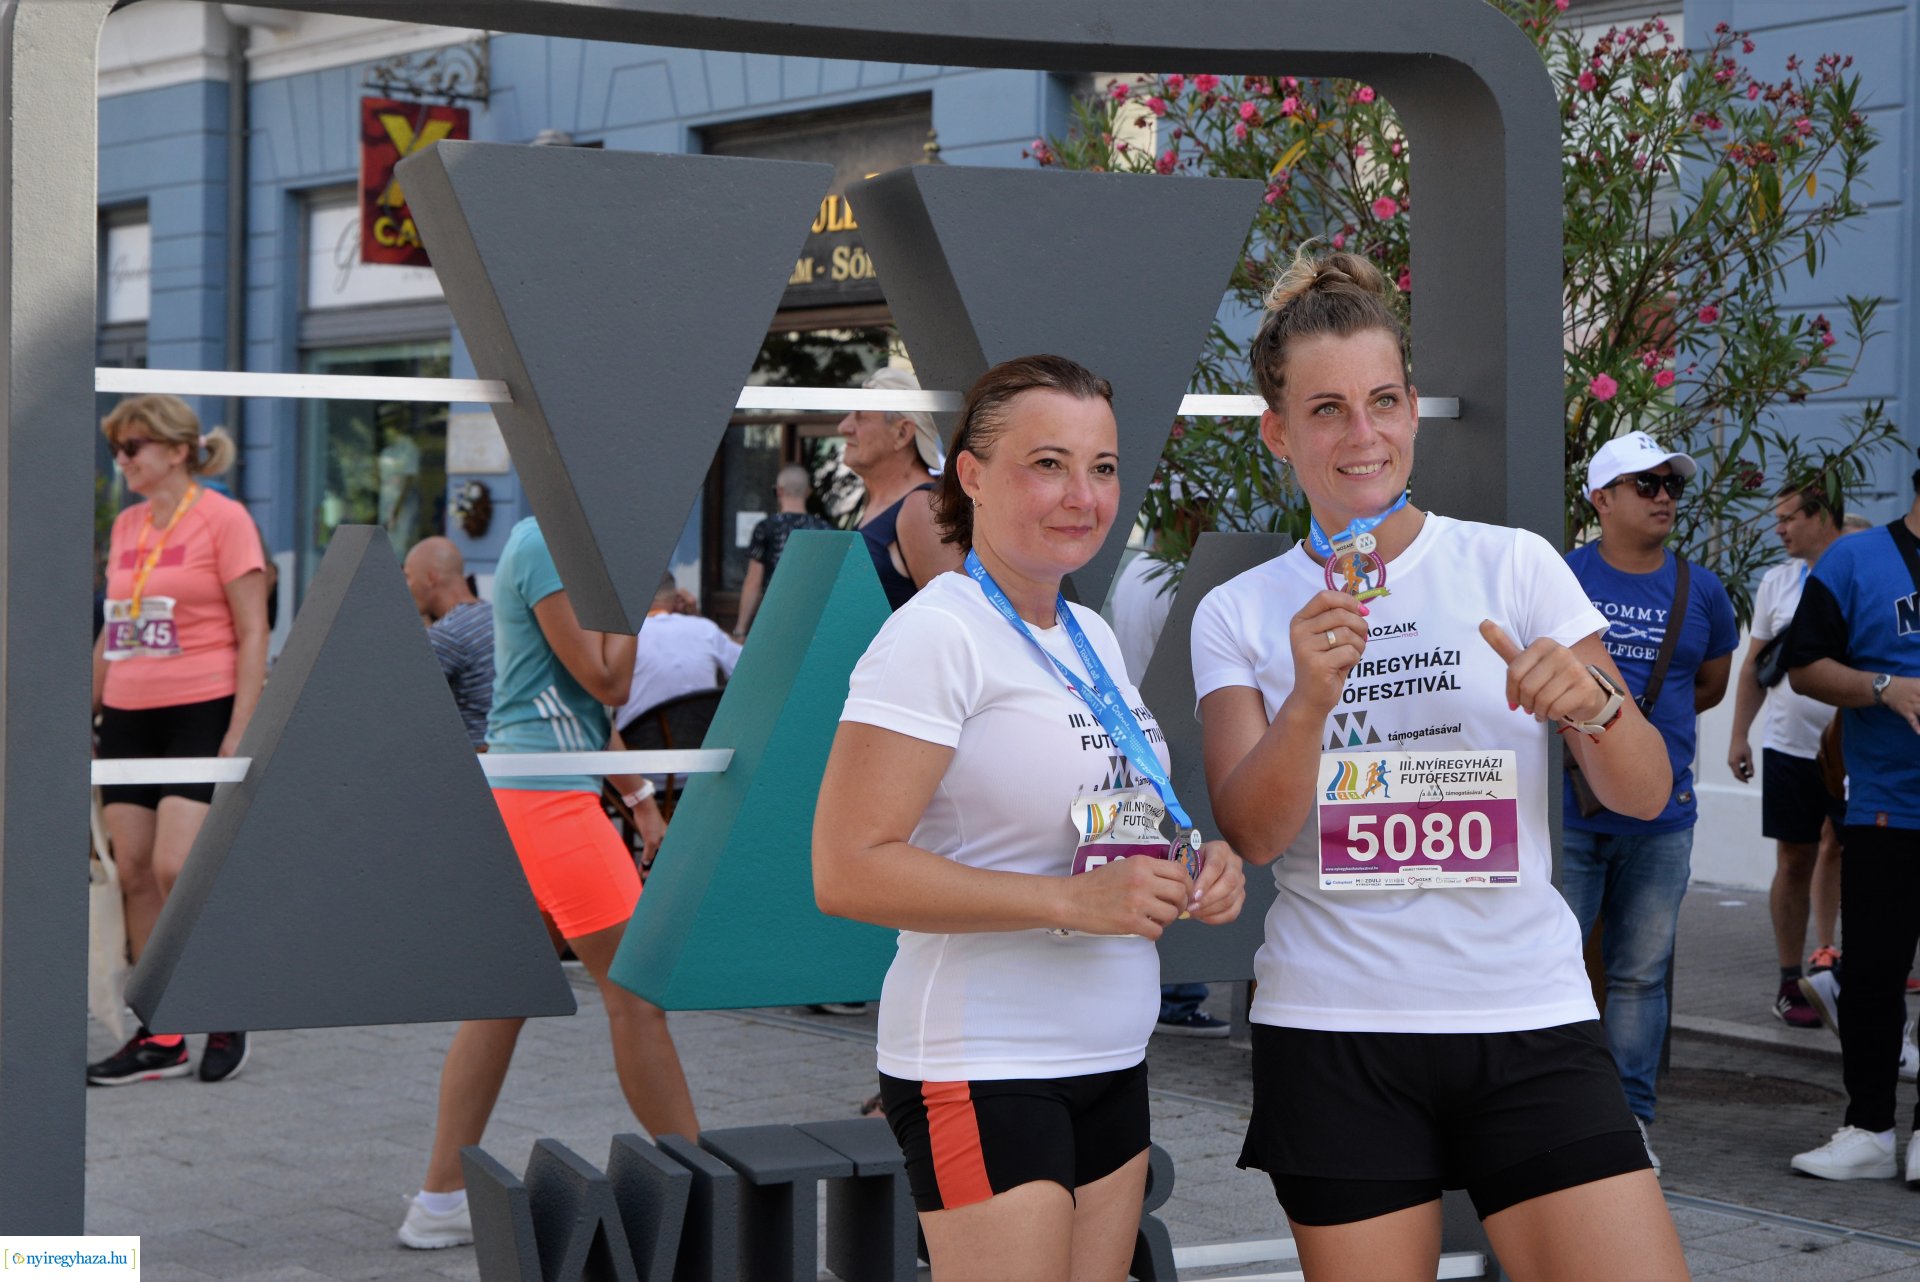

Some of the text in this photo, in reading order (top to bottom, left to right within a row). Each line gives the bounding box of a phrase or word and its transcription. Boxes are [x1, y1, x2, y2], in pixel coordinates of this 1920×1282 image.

[1401, 630, 1419, 639] med
[1387, 722, 1462, 742] támogatásával
[1400, 771, 1503, 785] FUTÓFESZTIVÁL
[1346, 811, 1492, 862] 5080
